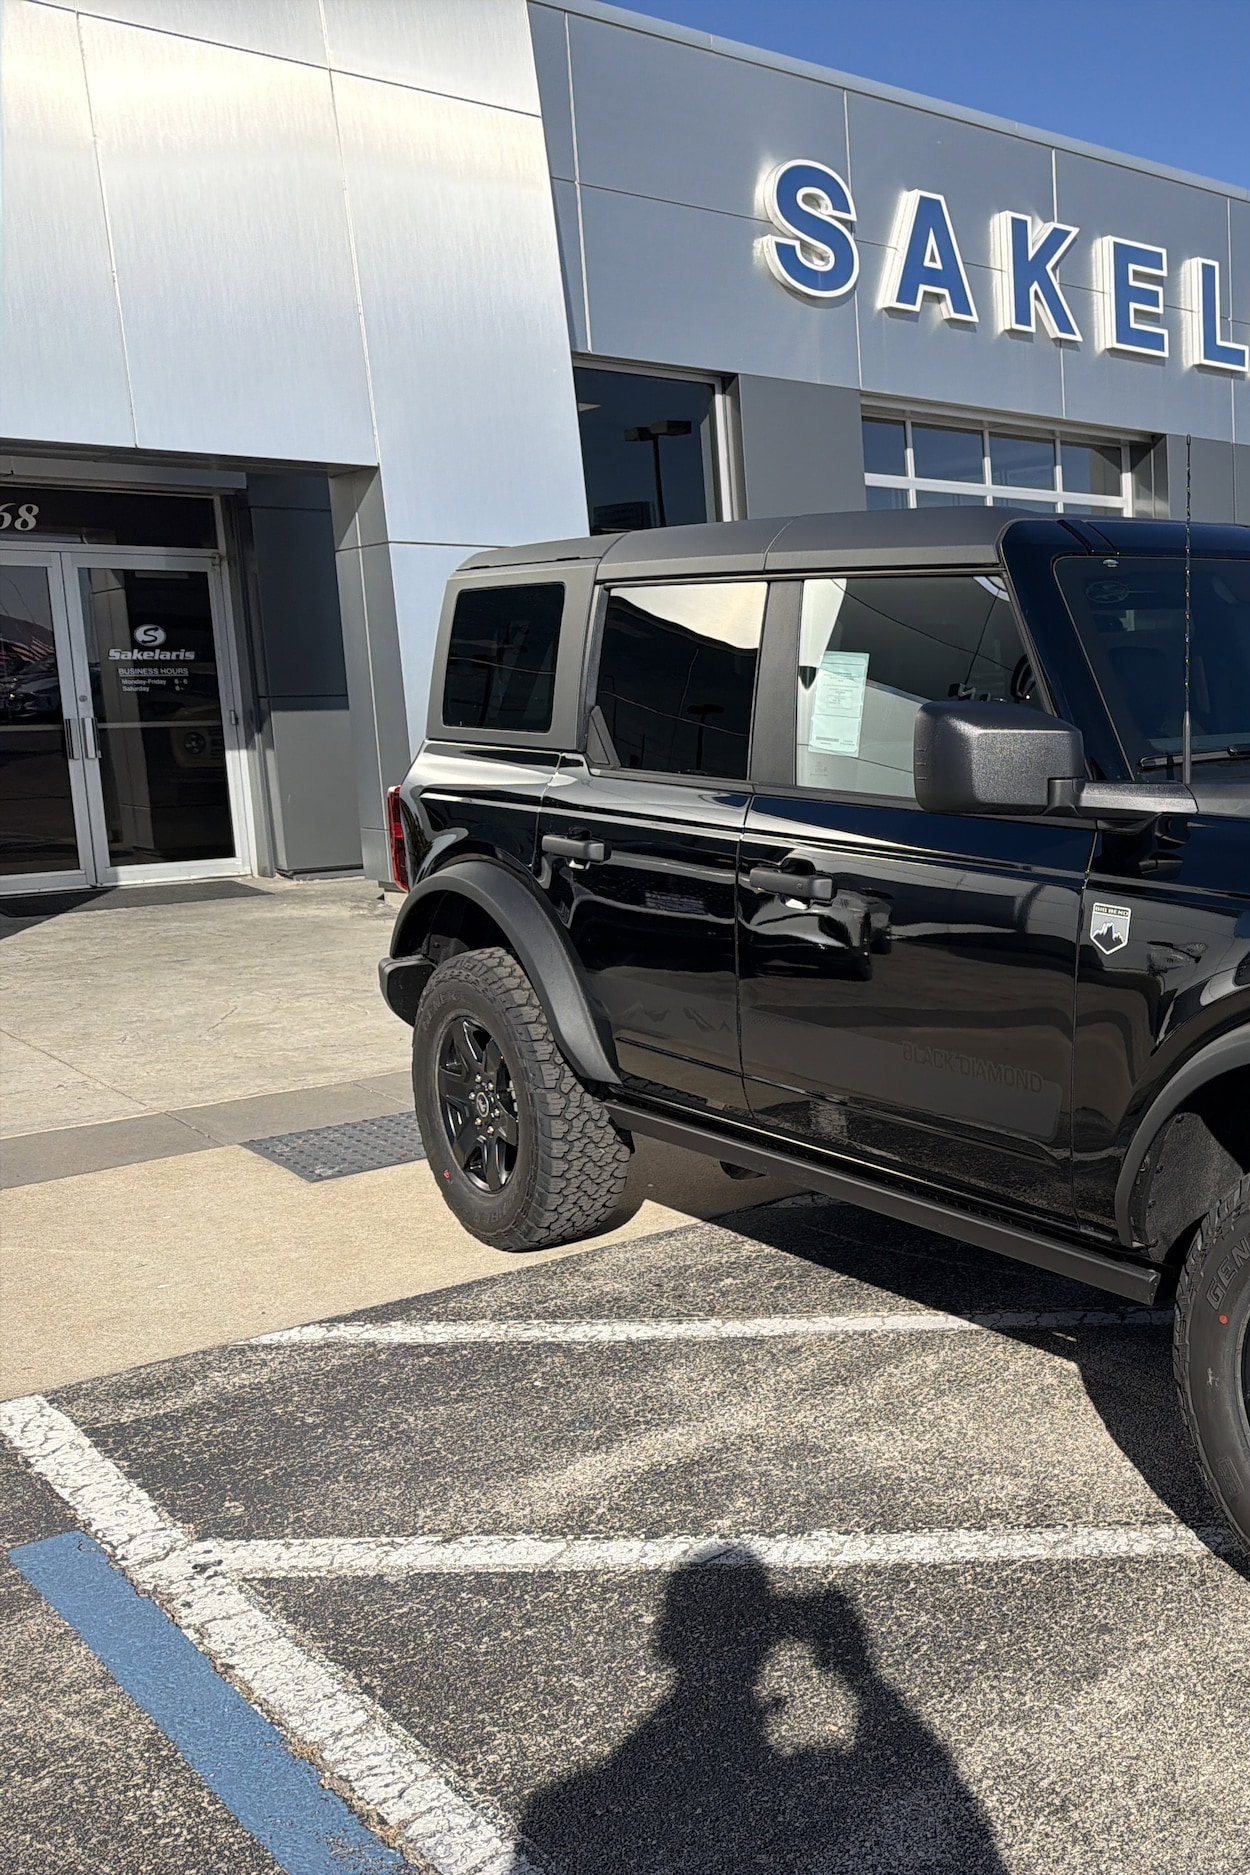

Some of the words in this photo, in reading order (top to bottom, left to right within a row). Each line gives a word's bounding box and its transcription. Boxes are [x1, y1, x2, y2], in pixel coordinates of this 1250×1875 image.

[108, 648, 196, 660] Sakelaris
[118, 667, 159, 675] BUSINESS
[160, 667, 189, 675] HOURS
[901, 1040, 955, 1073] BLACK
[957, 1055, 1046, 1094] DIAMOND
